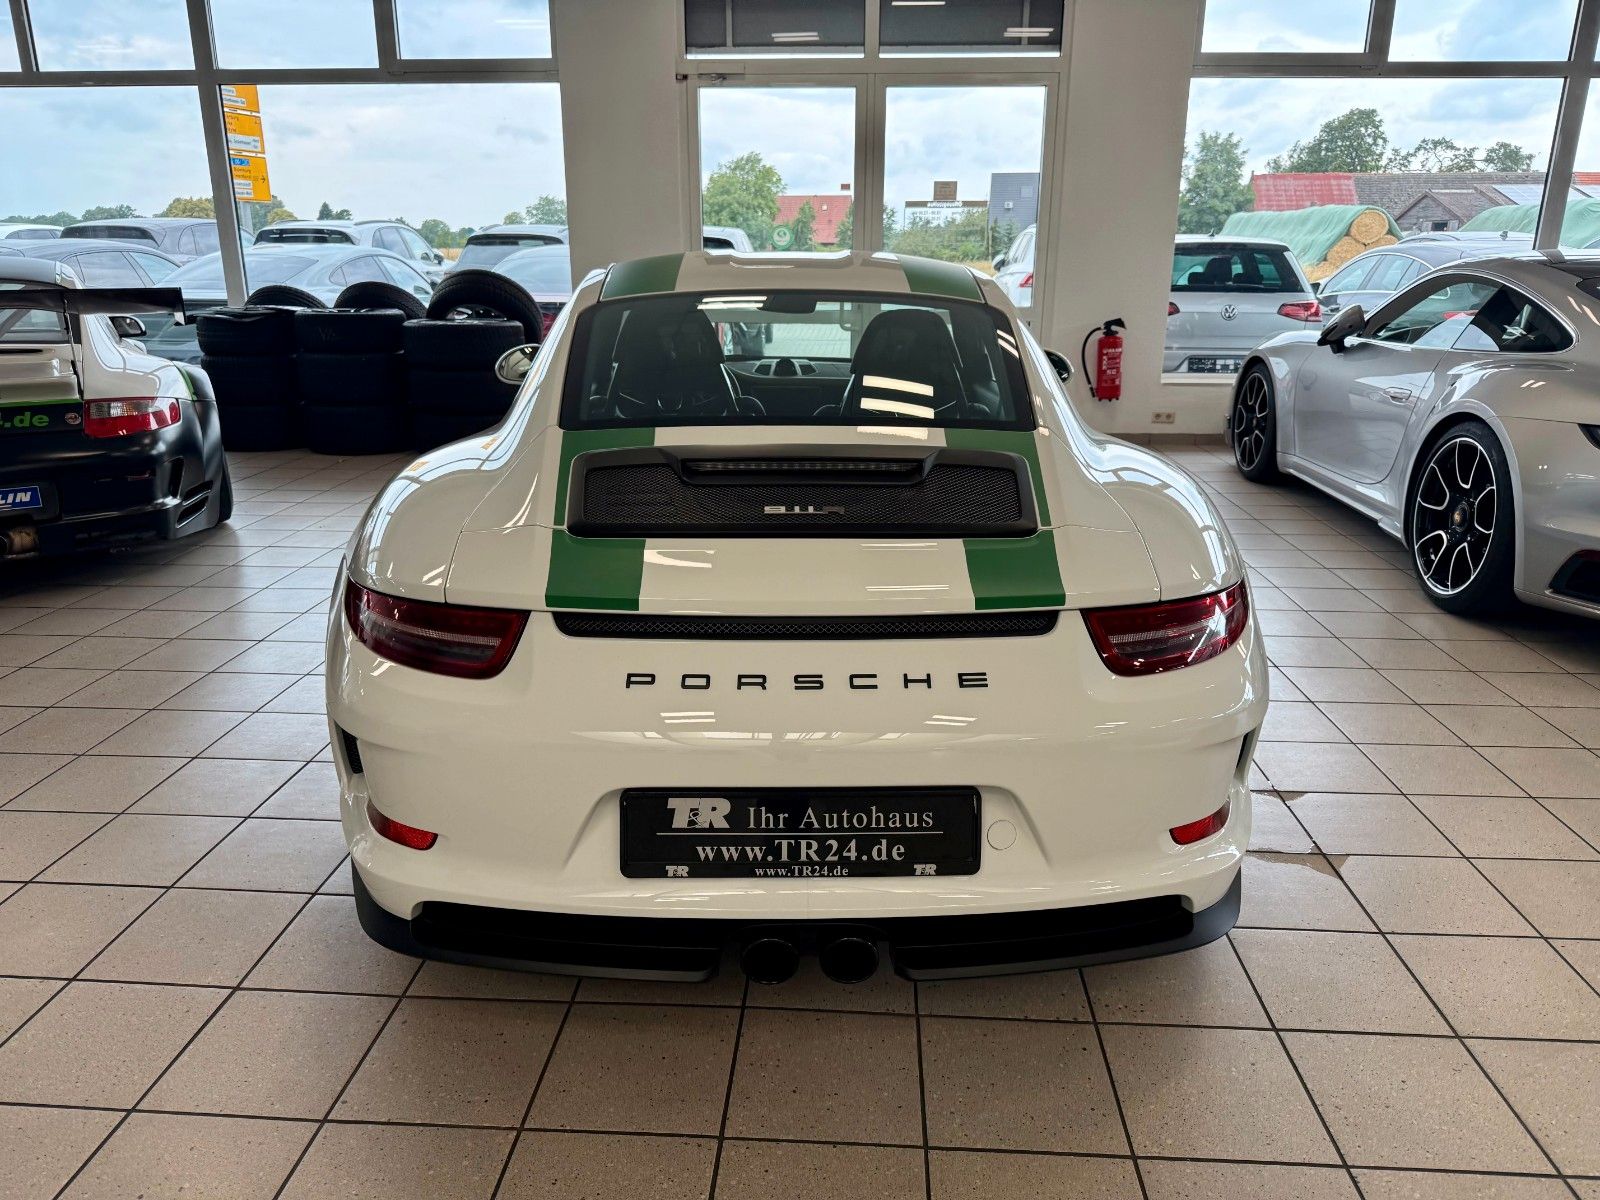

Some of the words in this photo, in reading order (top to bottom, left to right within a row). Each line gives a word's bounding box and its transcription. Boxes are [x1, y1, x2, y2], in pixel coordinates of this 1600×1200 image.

[0, 411, 49, 428] .de
[626, 672, 988, 690] PORSCHE
[747, 806, 789, 829] Ihr
[800, 806, 934, 829] Autohaus
[696, 839, 905, 863] www.TR24.de
[754, 865, 849, 877] www.TR24.de
